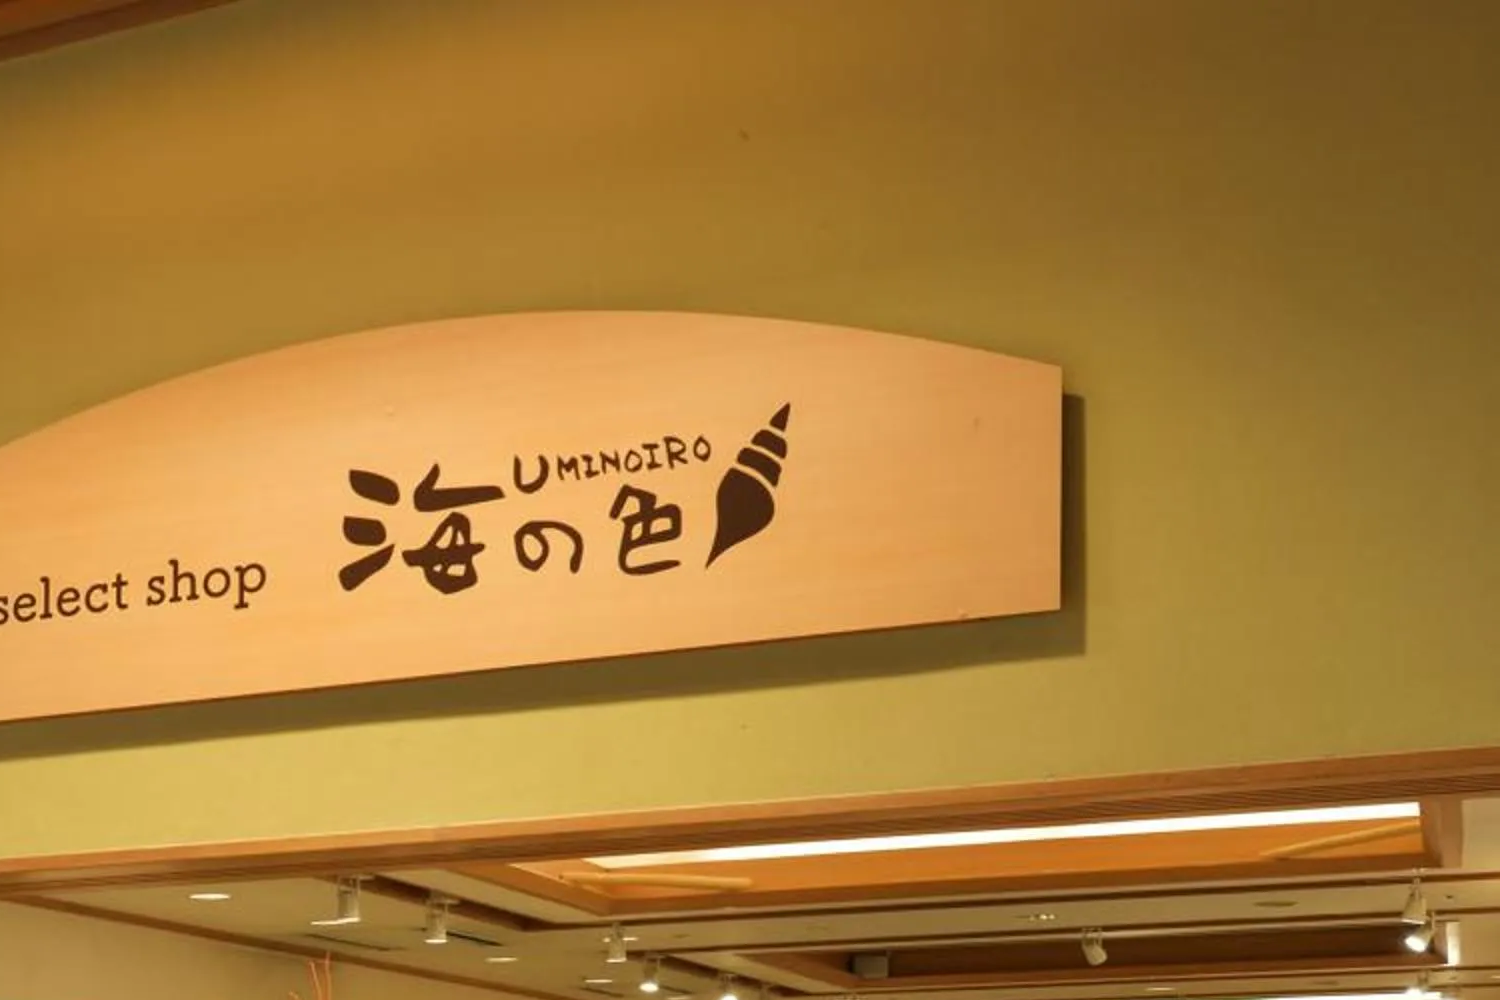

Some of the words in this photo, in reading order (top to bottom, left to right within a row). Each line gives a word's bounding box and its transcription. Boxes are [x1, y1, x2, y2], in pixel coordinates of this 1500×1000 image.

[512, 434, 712, 496] UMINOIRO
[337, 462, 683, 596] 海の色
[145, 558, 268, 611] shop
